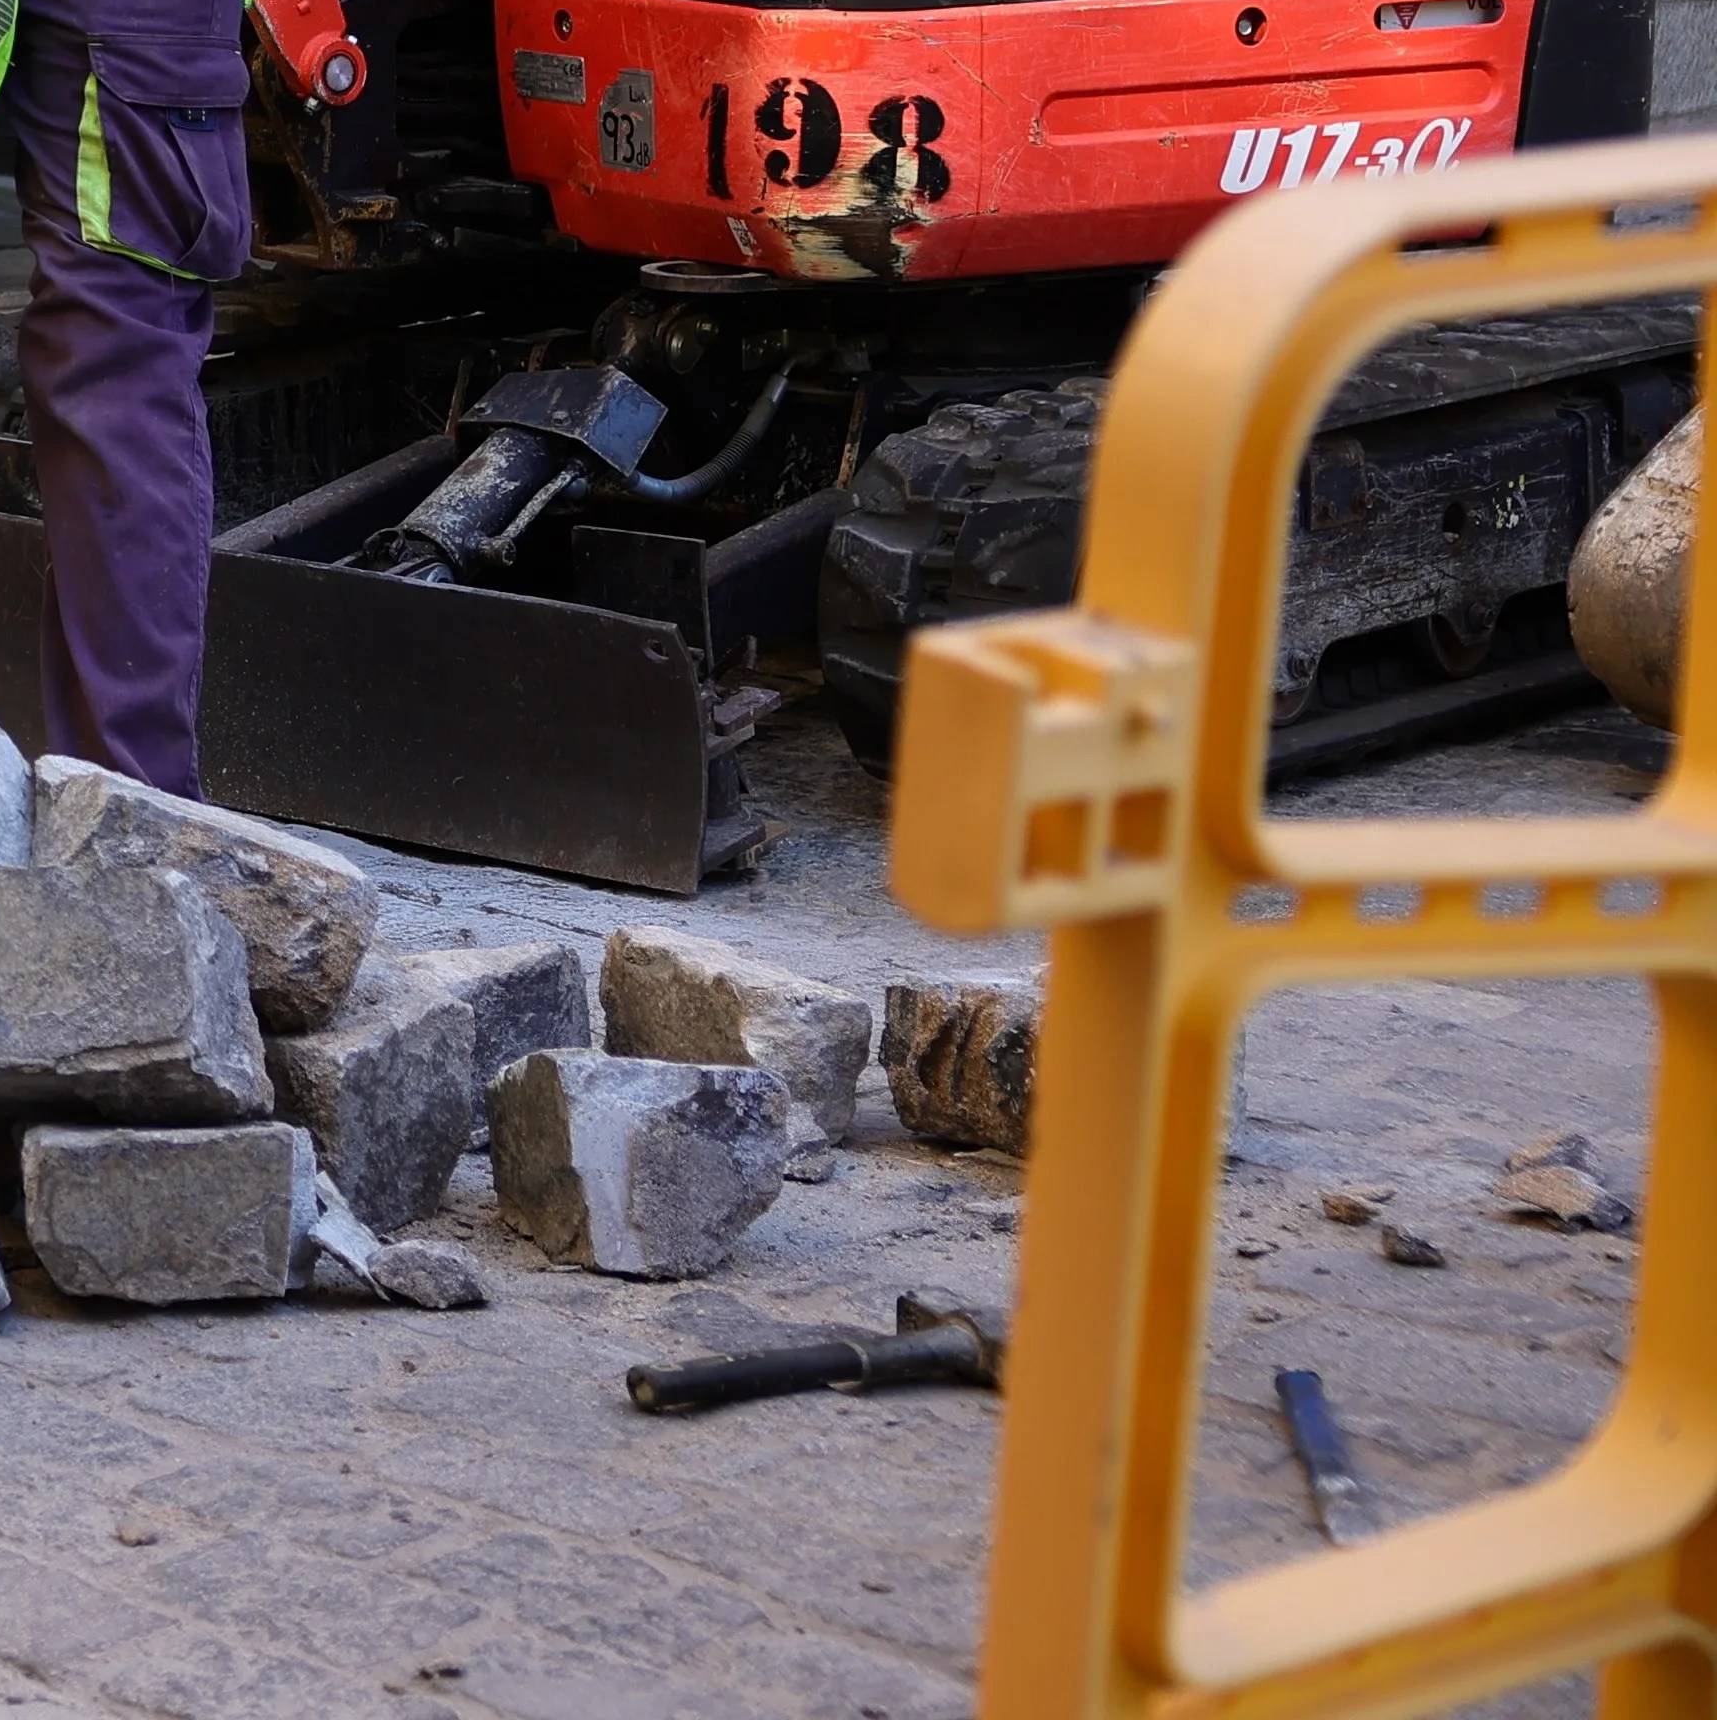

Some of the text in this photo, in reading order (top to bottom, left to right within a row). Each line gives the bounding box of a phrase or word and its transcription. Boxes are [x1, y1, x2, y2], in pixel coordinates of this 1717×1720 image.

[602, 111, 635, 164] 93
[636, 142, 651, 167] dB
[698, 76, 951, 203] 198
